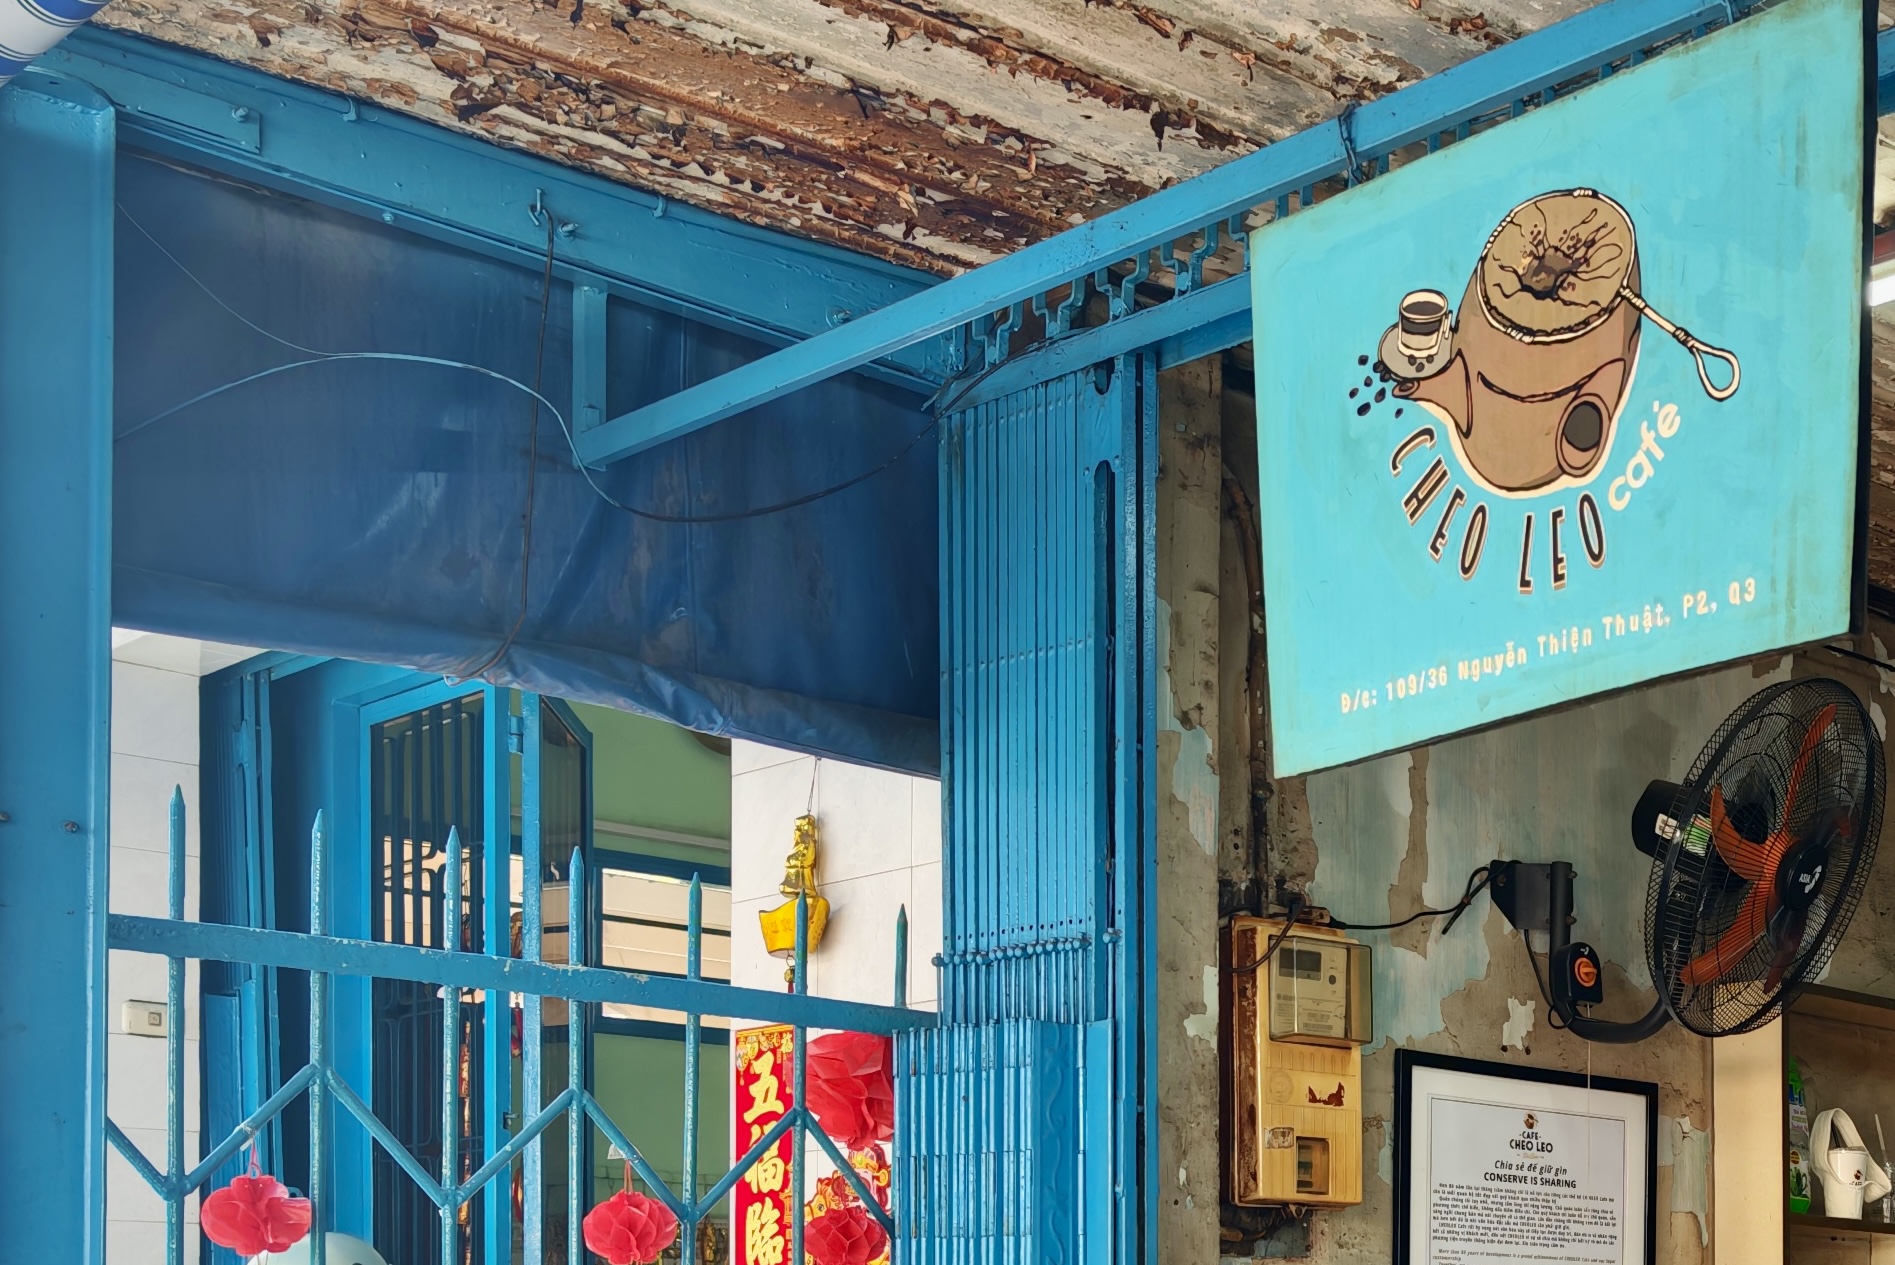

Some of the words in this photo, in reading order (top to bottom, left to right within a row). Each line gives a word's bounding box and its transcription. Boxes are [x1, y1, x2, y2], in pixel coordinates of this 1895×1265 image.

[1607, 400, 1682, 512] café
[1390, 425, 1489, 580] CHEO
[1517, 492, 1607, 593] LEO
[1386, 665, 1448, 701] 109/36
[1458, 641, 1527, 682] Nguyễn
[1537, 626, 1592, 657] Thiện
[1602, 603, 1671, 641] Thuật,
[1683, 590, 1717, 619] P2,
[1729, 577, 1756, 606] Q3
[1522, 1131, 1539, 1140] CAFE
[1509, 1139, 1534, 1151] CHEO
[1536, 1142, 1553, 1153] LEO
[1494, 1160, 1513, 1170] Chia
[1515, 1162, 1525, 1171] sẻ
[1539, 1164, 1554, 1175] giữ
[1554, 1166, 1567, 1177] gìn
[1484, 1172, 1528, 1184] CONSERVE
[1530, 1176, 1538, 1185] IS
[1540, 1177, 1576, 1189] SHARING
